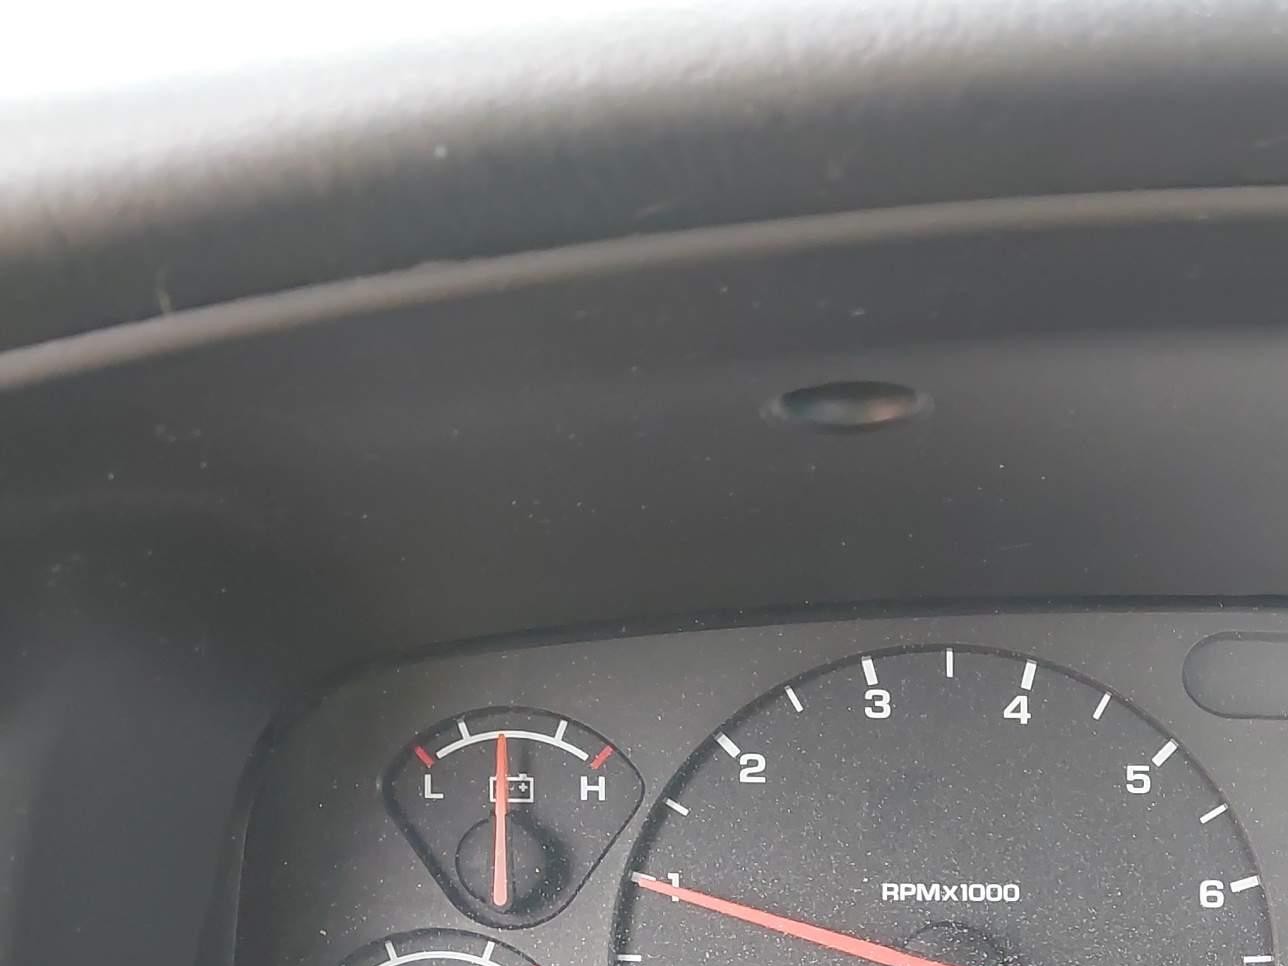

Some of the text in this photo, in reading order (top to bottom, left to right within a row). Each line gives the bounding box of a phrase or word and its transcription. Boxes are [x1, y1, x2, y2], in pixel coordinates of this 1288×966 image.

[865, 690, 891, 719] 3
[1003, 696, 1032, 725] 4
[740, 753, 767, 783] 2
[1126, 765, 1151, 794] 5
[424, 774, 444, 800] L
[580, 775, 606, 801] H
[667, 872, 680, 902] 1
[1199, 880, 1224, 909] 6
